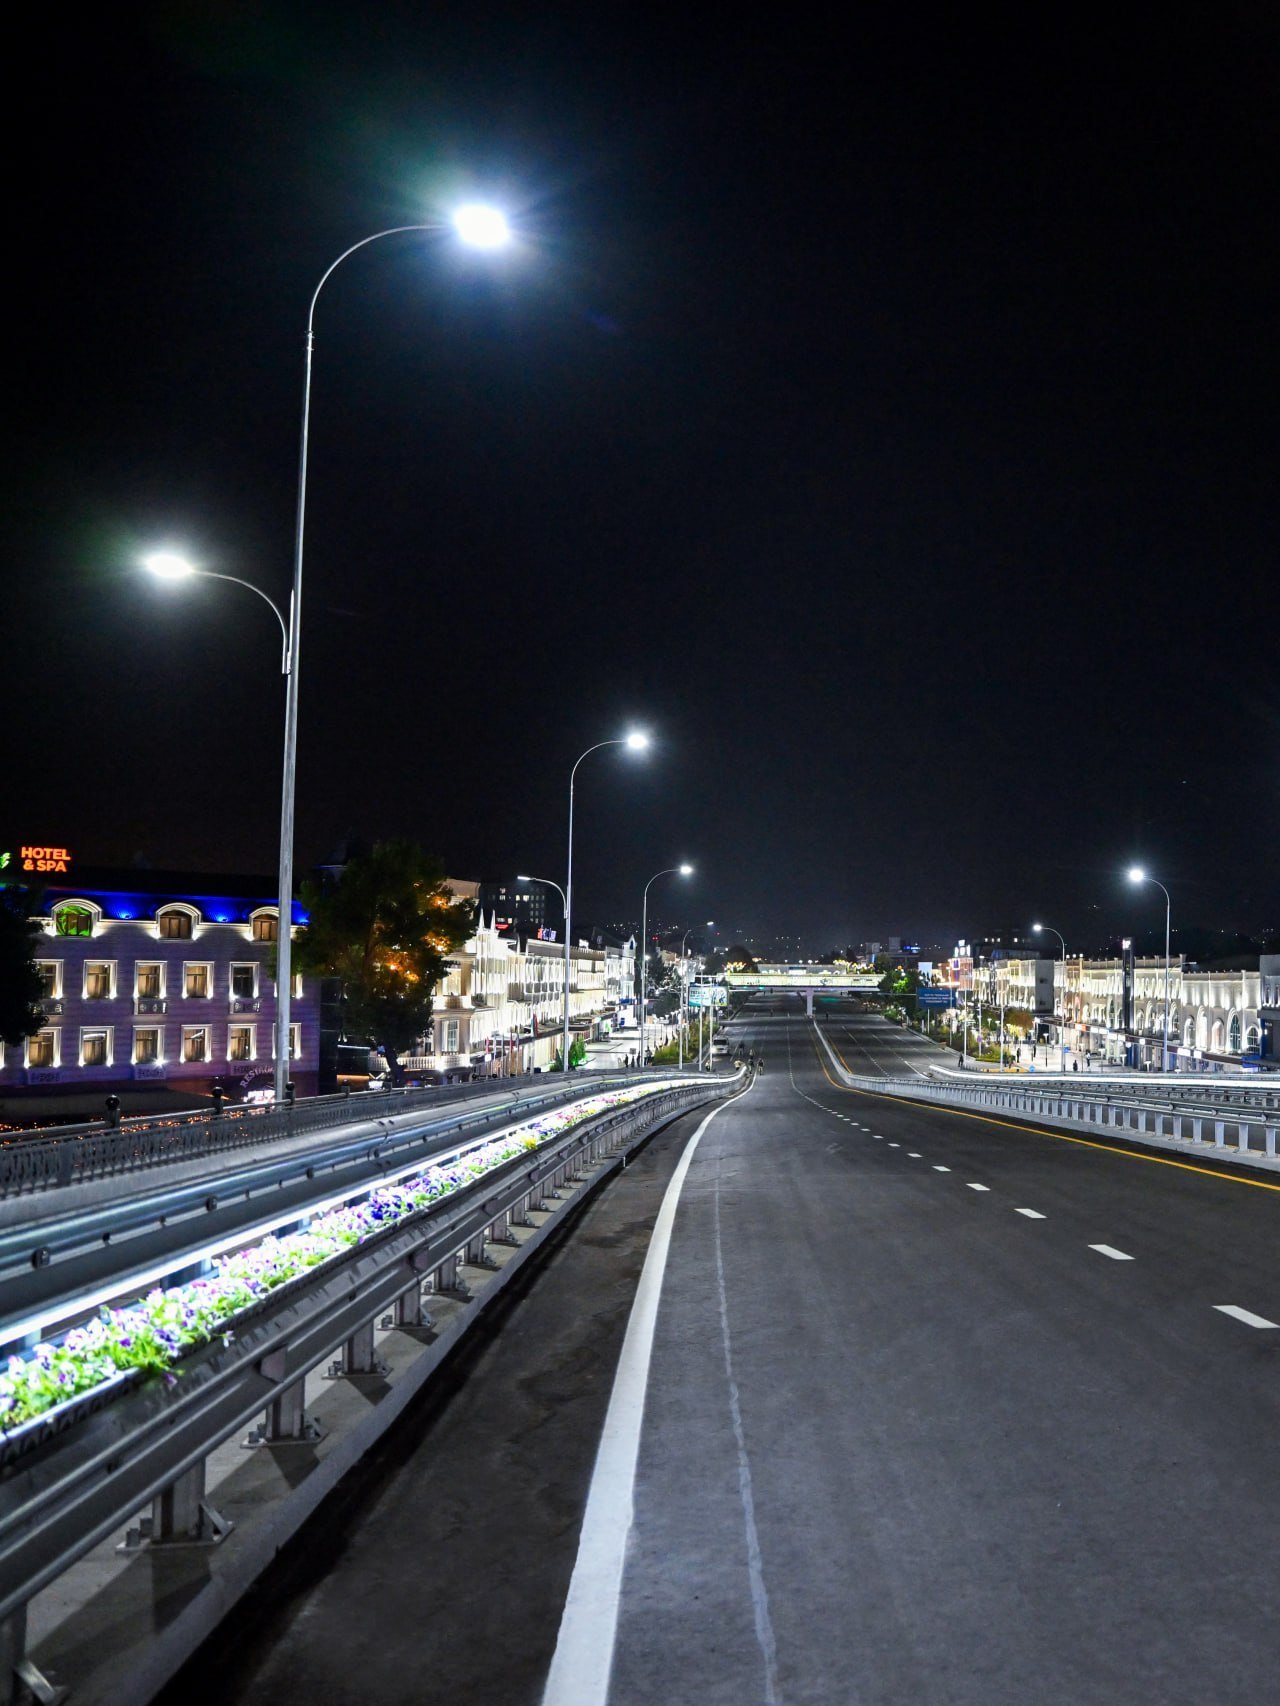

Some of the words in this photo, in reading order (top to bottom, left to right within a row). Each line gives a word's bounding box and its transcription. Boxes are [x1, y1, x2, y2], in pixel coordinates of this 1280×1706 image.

[21, 846, 71, 860] HOTEL
[23, 859, 34, 871] &
[36, 860, 67, 872] SPA
